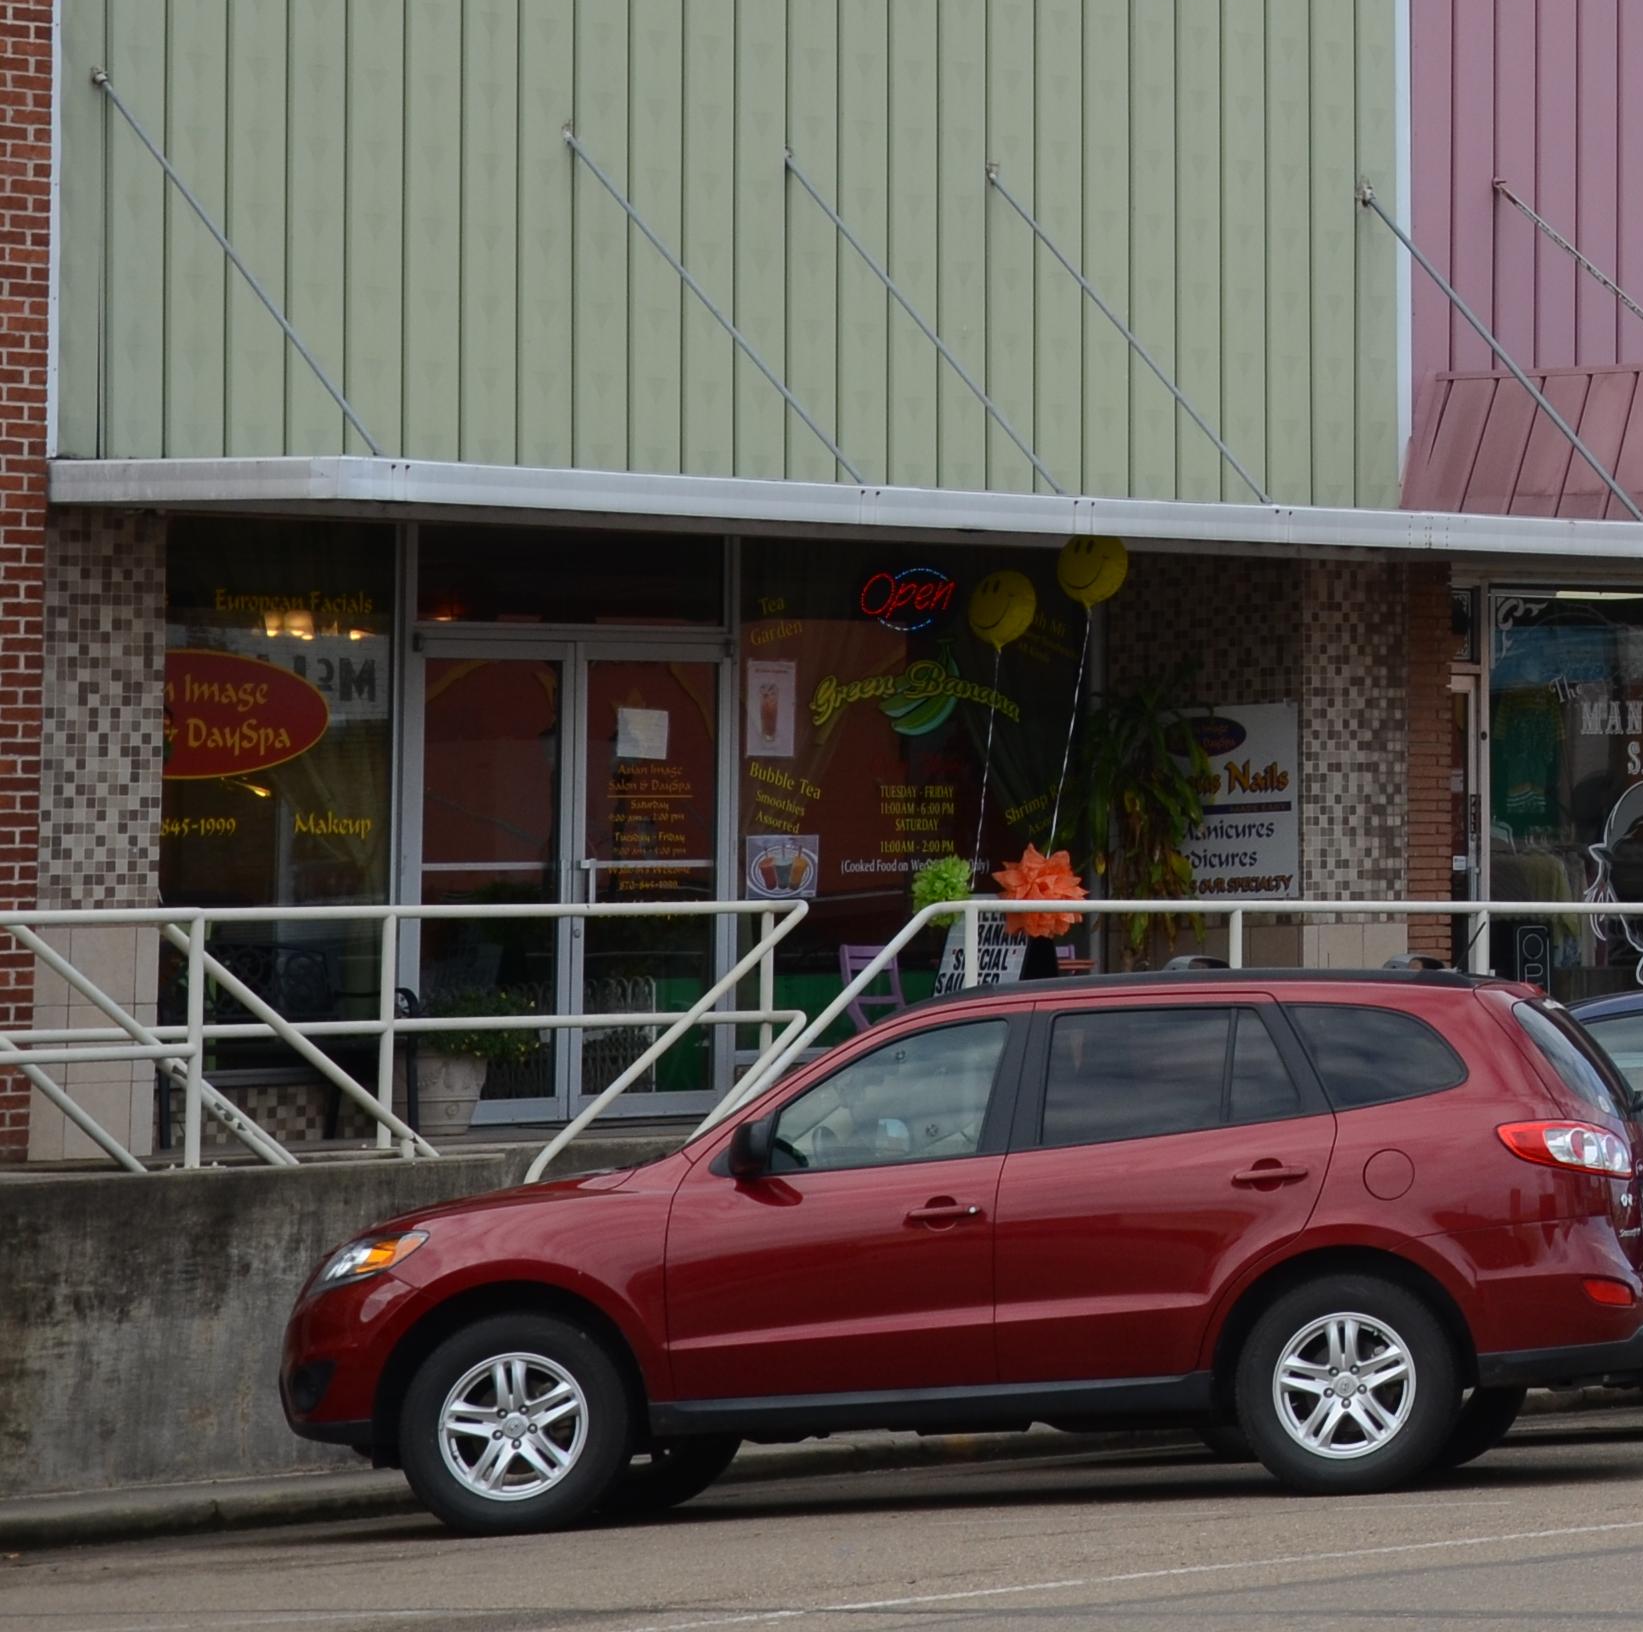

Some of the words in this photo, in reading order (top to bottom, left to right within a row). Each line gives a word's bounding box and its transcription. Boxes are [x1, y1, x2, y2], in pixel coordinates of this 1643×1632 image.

[215, 588, 305, 613] European
[310, 591, 375, 614] Facials
[758, 596, 785, 616] Tea
[860, 571, 958, 620] Open
[750, 621, 803, 647] Garden
[184, 674, 269, 712] Image
[810, 675, 897, 727] Green
[904, 659, 1022, 723] Banana
[186, 718, 292, 757] DaySpa
[749, 761, 795, 790] Bubble
[800, 778, 822, 800] Tea
[1224, 759, 1290, 796] Nails
[756, 790, 806, 816] Smoothies
[880, 785, 917, 799] TUESDAY
[924, 785, 954, 799] FRIDAY
[755, 810, 801, 834] Assorted
[941, 803, 955, 816] PM
[159, 817, 238, 837] 845-1999
[293, 810, 373, 839] Makeup
[895, 818, 940, 832] SATURDAY
[922, 840, 940, 853] 2:00
[940, 840, 955, 853] PM
[876, 859, 897, 872] Food
[898, 862, 909, 871] on
[1227, 873, 1293, 895] SPECIALTY
